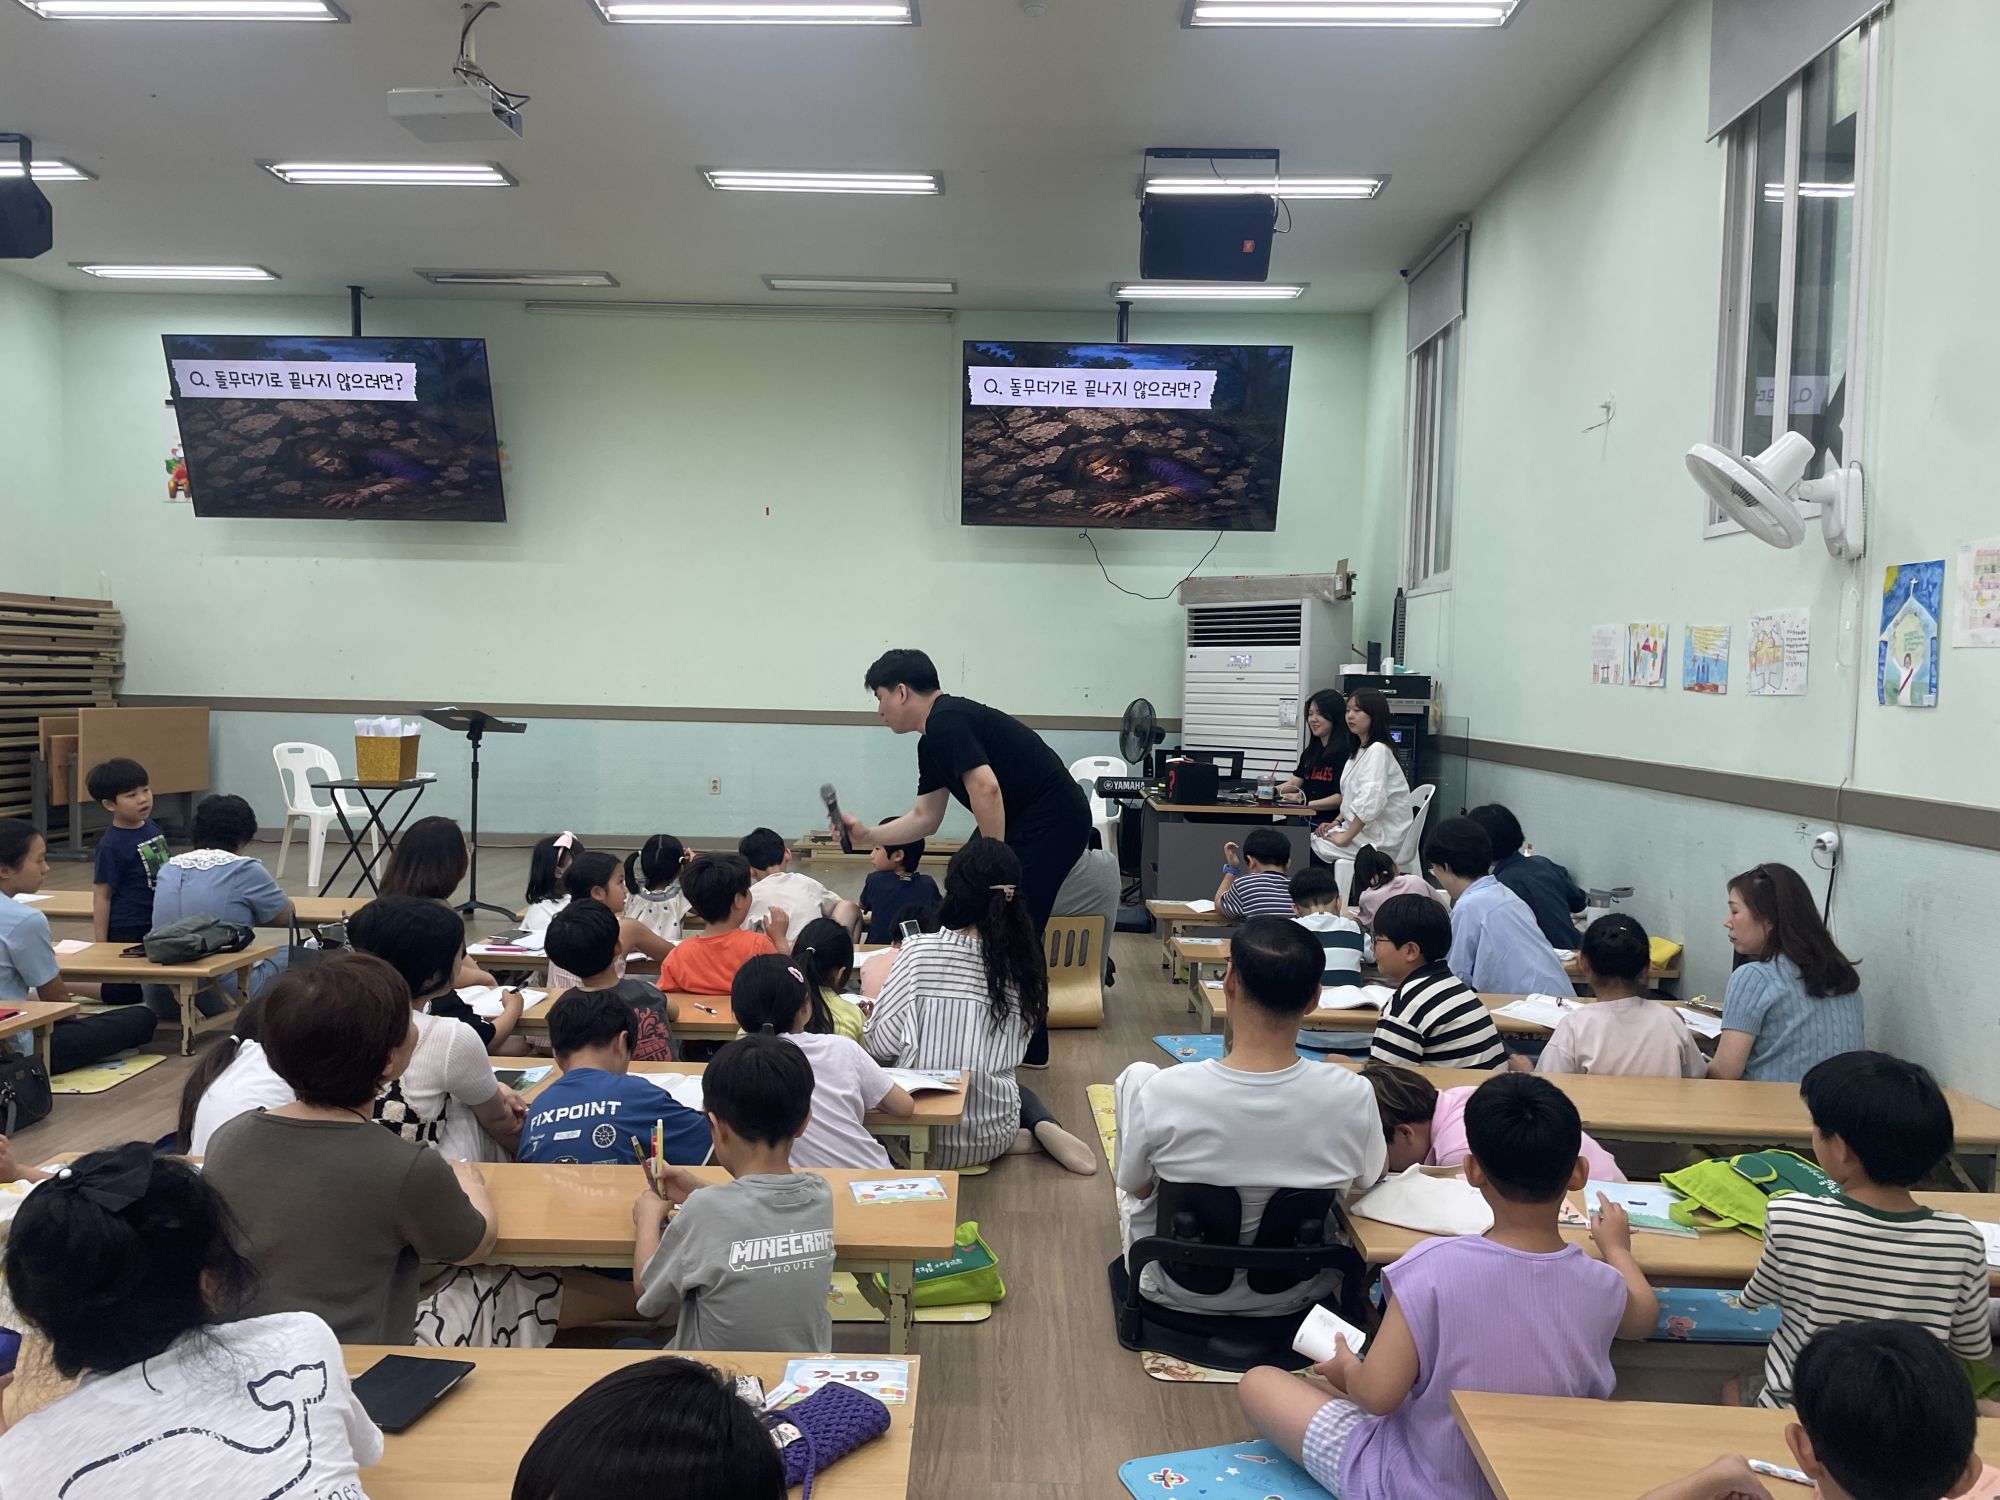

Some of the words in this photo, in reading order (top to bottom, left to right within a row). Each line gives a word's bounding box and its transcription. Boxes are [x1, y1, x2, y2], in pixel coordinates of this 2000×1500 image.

[189, 371, 210, 388] Q.
[214, 370, 283, 389] 돌무더기로
[288, 371, 332, 390] 끝나지
[336, 372, 403, 392] 않으려면?
[983, 378, 1003, 395] Q.
[1009, 378, 1078, 397] 돌무더기로
[1084, 379, 1128, 398] 끝나지
[1133, 380, 1202, 399] 않으려면?
[1113, 780, 1146, 790] YAMAHA
[530, 1100, 622, 1132] FIXPOINT
[731, 1230, 834, 1264] MINECRAF
[773, 1260, 815, 1274] MOVIE
[813, 1370, 880, 1382] 2-19
